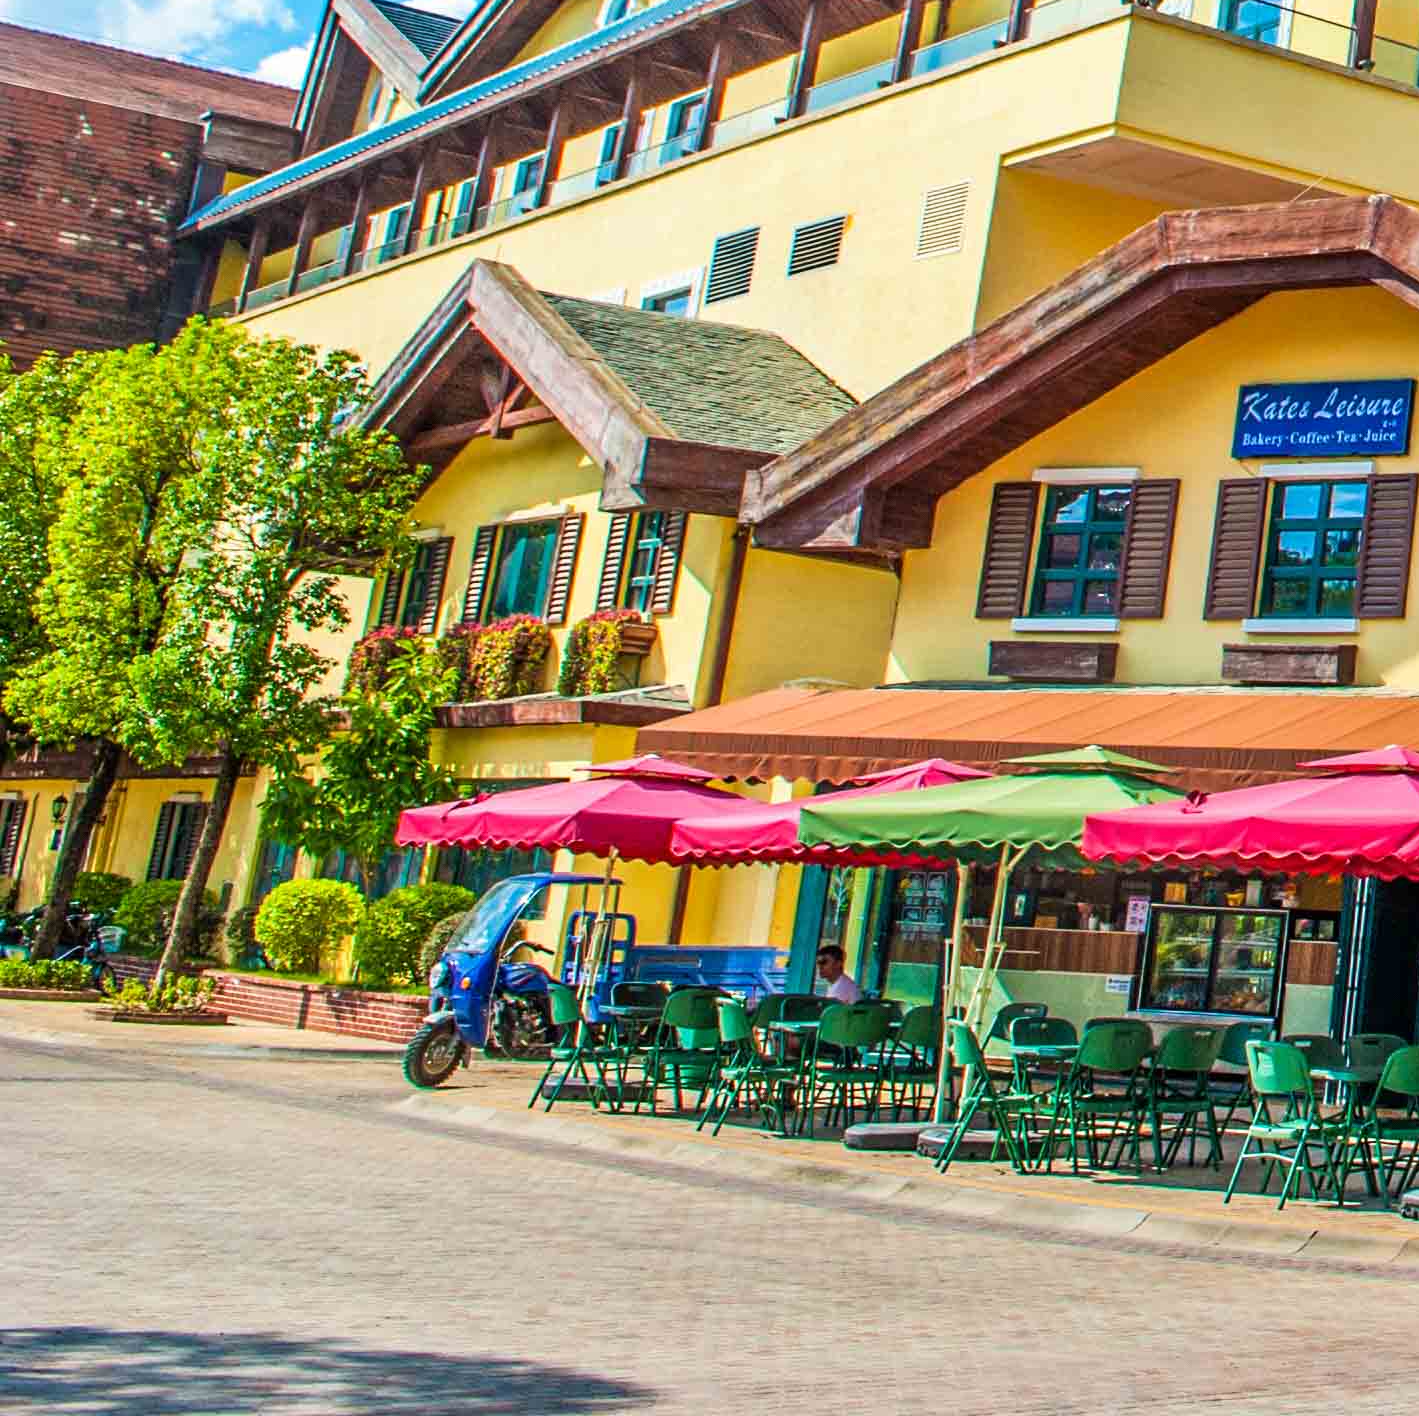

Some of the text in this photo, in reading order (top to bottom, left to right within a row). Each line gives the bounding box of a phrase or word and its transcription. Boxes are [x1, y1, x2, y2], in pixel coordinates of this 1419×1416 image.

[1313, 387, 1404, 419] Leisure
[1242, 432, 1282, 447] Bakery
[1290, 431, 1330, 444] Coffee
[1364, 428, 1397, 442] Juice
